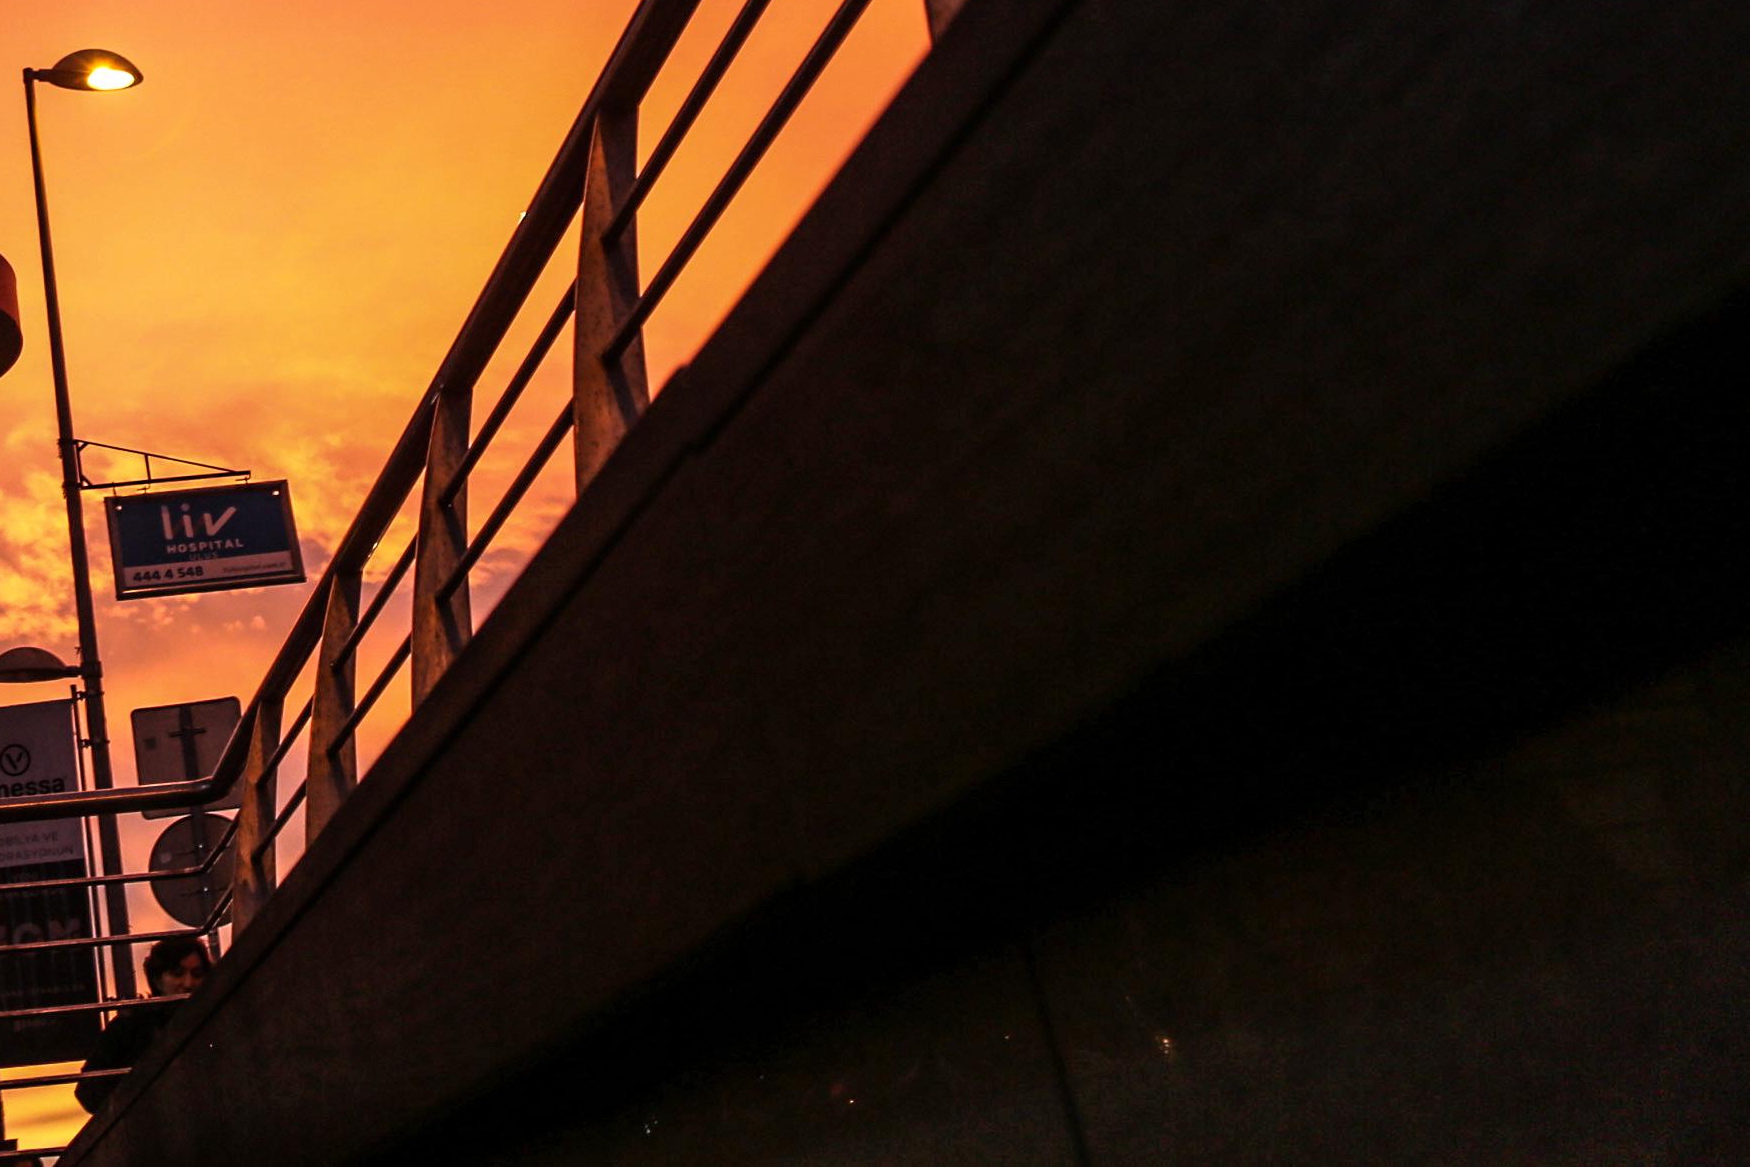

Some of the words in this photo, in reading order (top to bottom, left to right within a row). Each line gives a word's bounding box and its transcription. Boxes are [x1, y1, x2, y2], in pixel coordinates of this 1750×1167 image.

[160, 503, 237, 540] liv
[165, 537, 245, 556] HOSPITAL
[133, 568, 161, 582] 444
[164, 568, 174, 580] 4
[177, 565, 204, 579] 548
